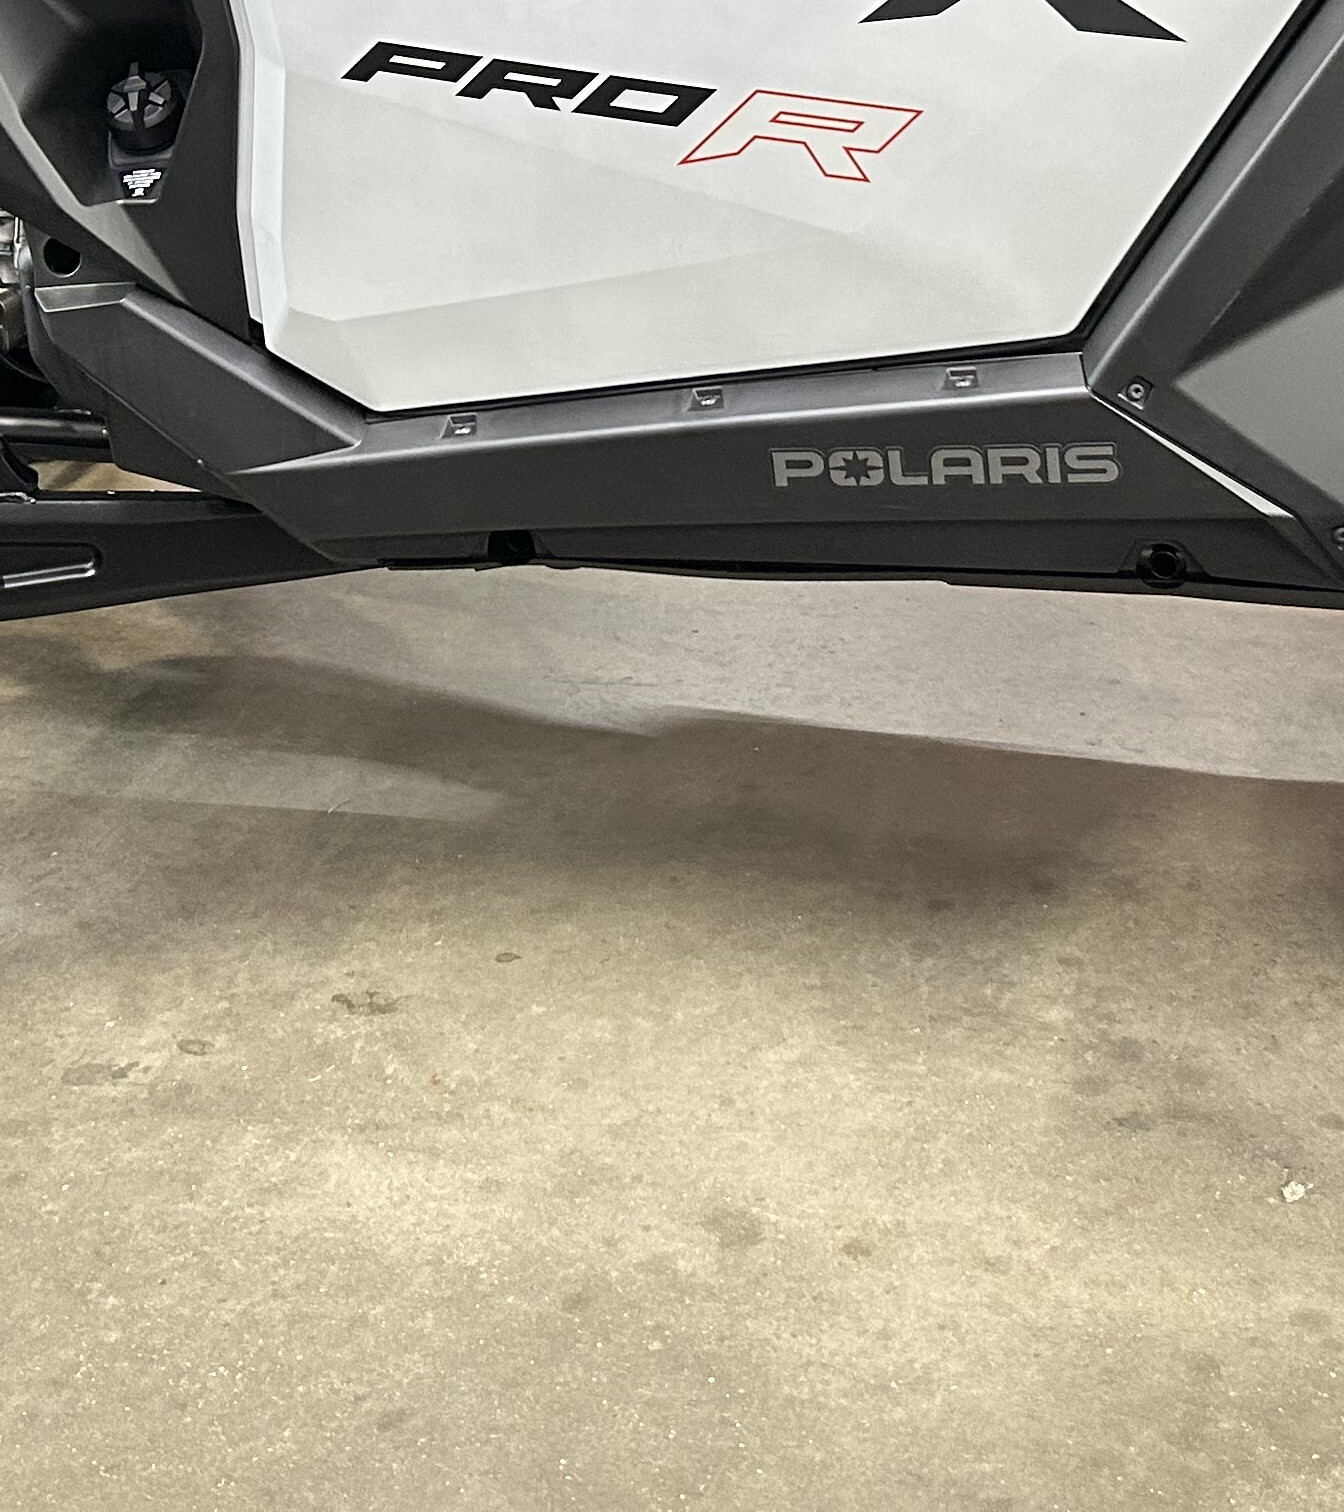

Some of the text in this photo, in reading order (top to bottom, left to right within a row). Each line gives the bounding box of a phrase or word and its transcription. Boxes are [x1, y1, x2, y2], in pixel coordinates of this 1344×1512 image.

[341, 41, 924, 183] PRO R
[770, 444, 1121, 488] POLARIS
